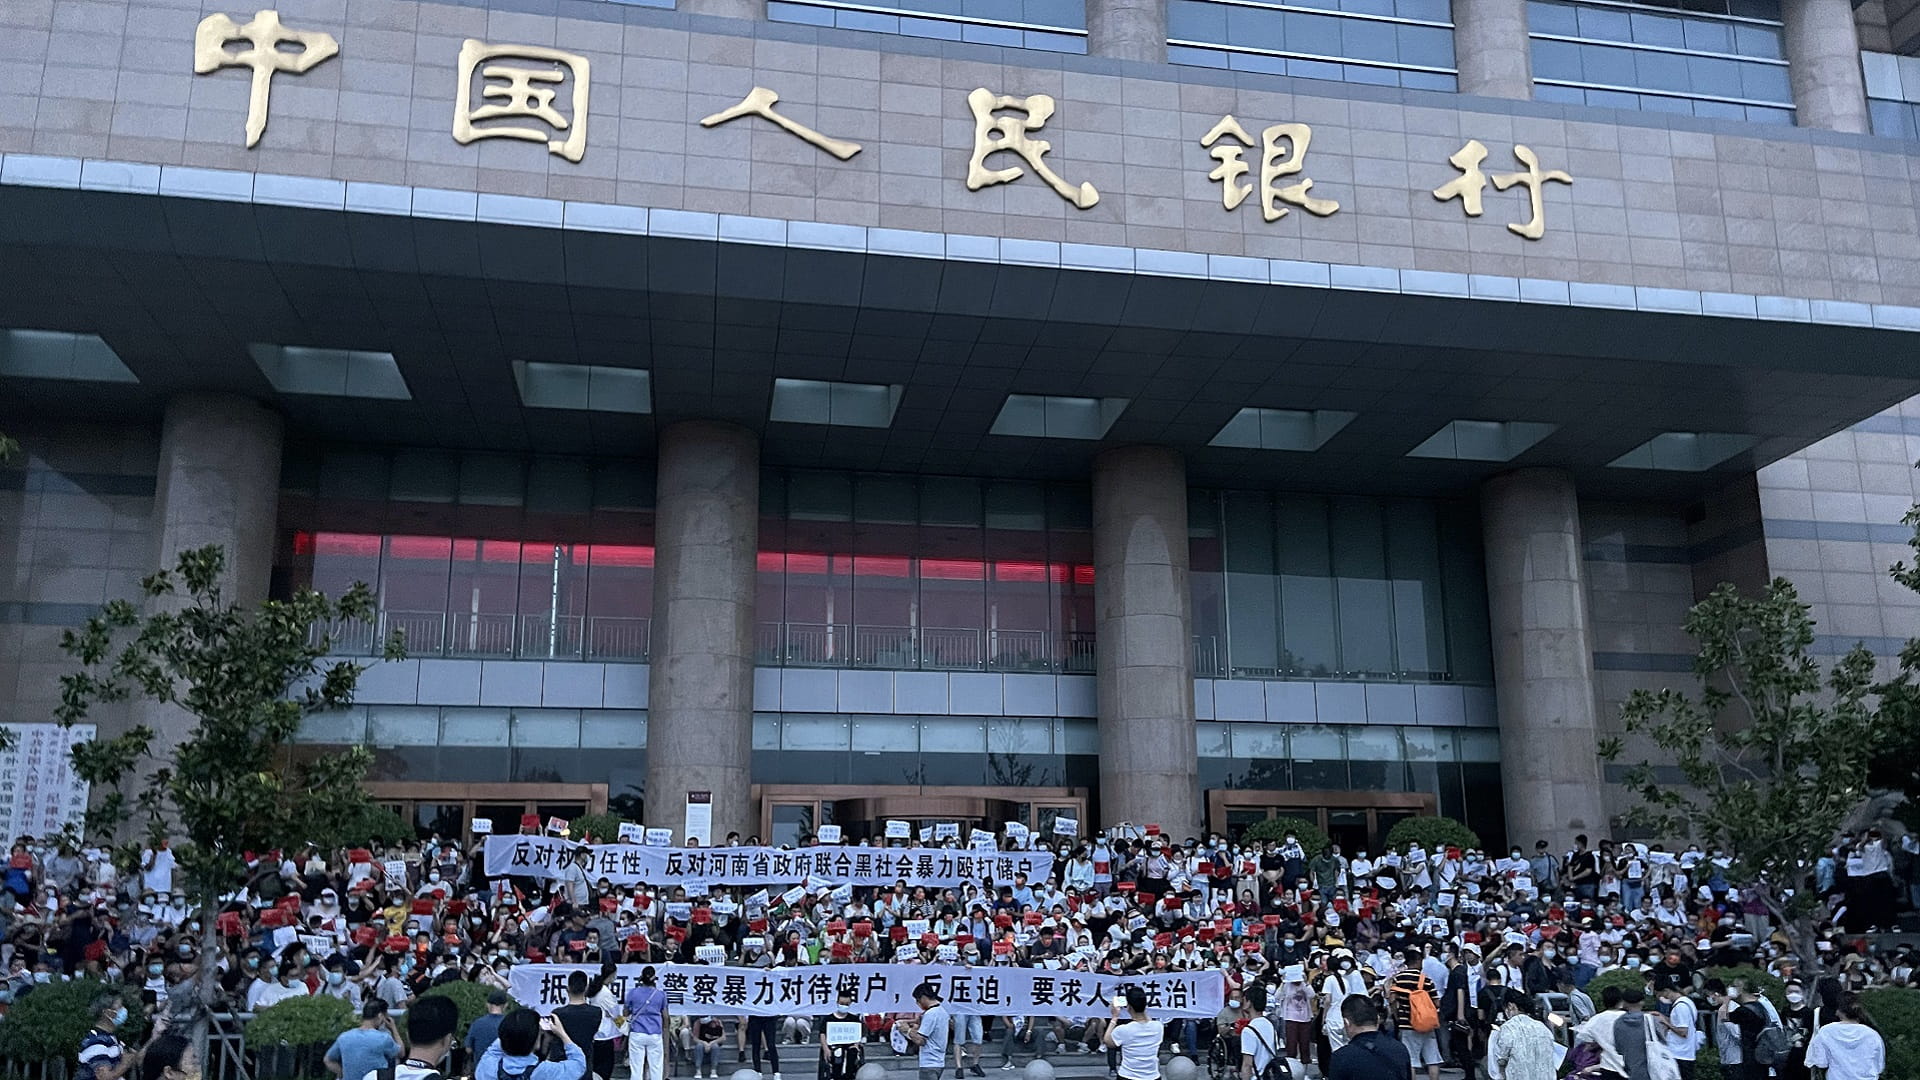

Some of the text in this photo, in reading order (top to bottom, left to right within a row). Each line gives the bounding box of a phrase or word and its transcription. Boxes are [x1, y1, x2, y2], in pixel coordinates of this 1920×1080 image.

[194, 10, 1572, 239] 中国人民银行
[540, 972, 1196, 1009] 抵河警察暴力对待储户，反压迫，要求人法治！
